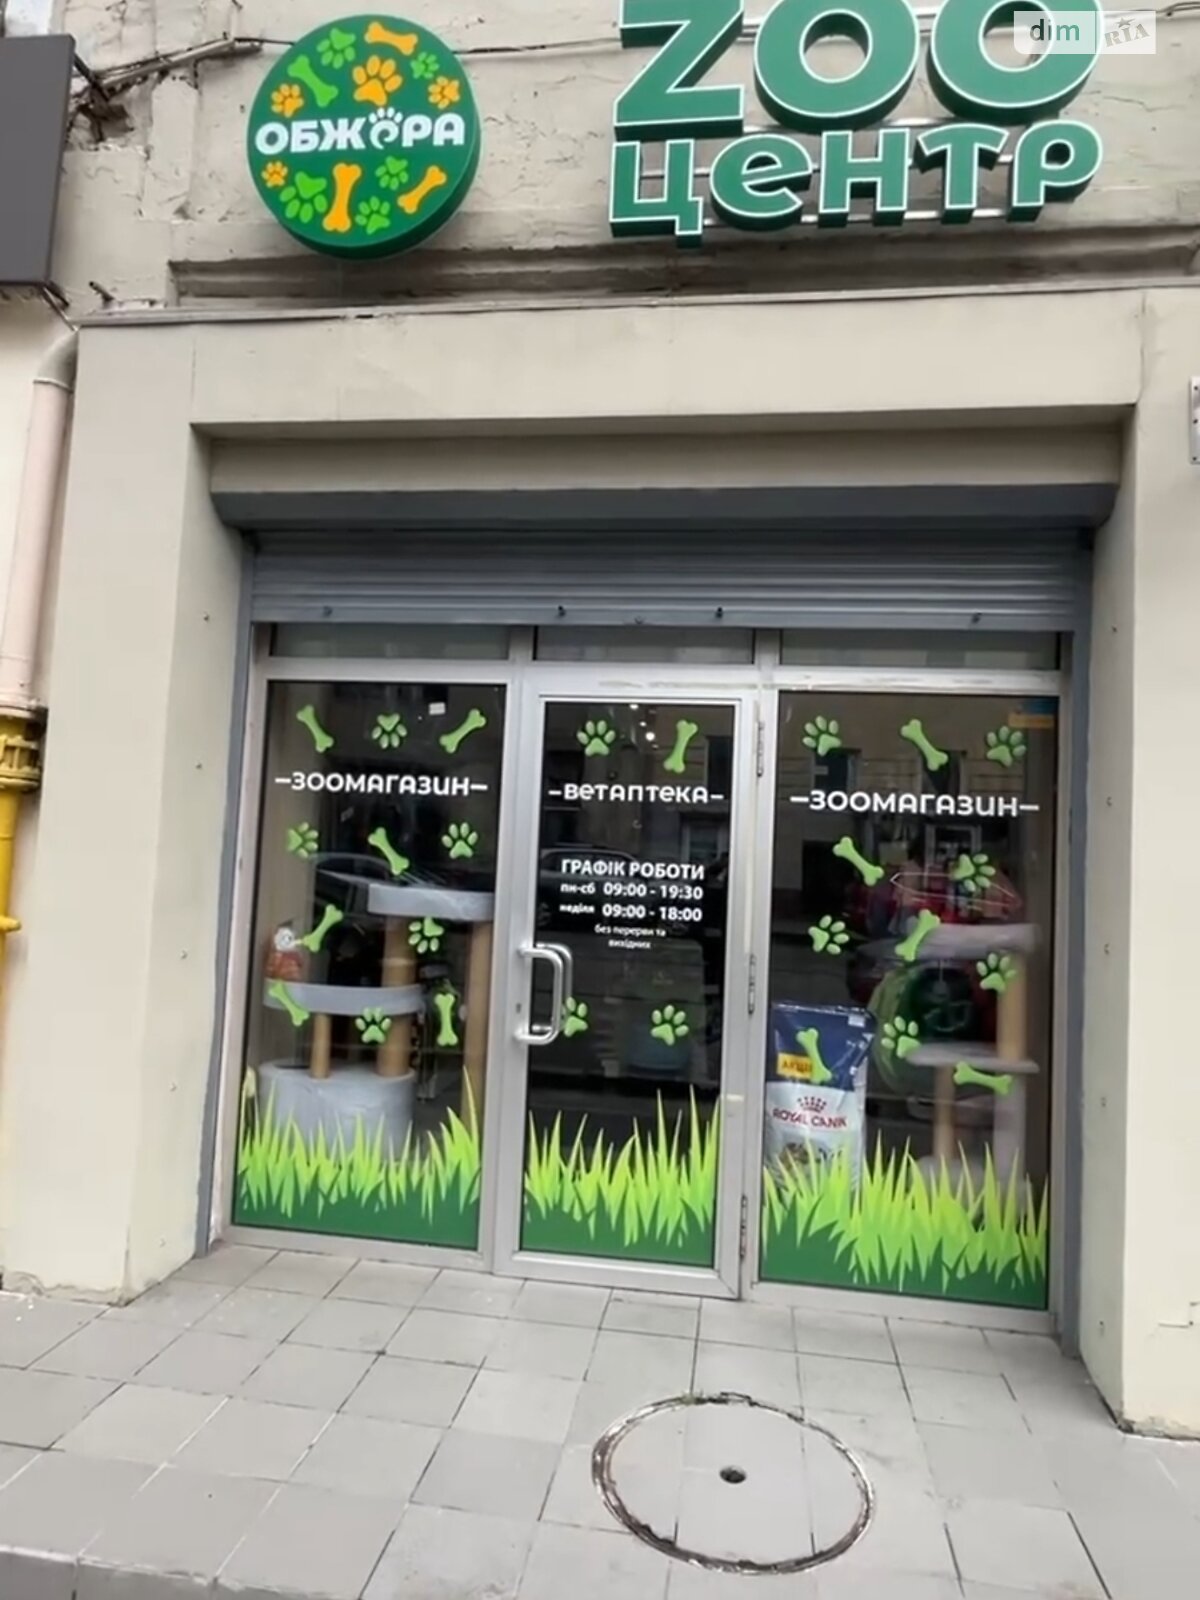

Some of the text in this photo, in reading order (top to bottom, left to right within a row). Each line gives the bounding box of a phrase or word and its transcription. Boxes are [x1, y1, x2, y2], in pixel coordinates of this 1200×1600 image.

[255, 107, 466, 155] ОБЖОРА
[561, 859, 705, 880] ГРАФІК РОБОТИ
[560, 882, 596, 895] пн-сб
[603, 882, 647, 897] 09:00
[660, 884, 704, 900] 19:30
[602, 903, 646, 919] 09:00
[659, 906, 703, 922] 18:00
